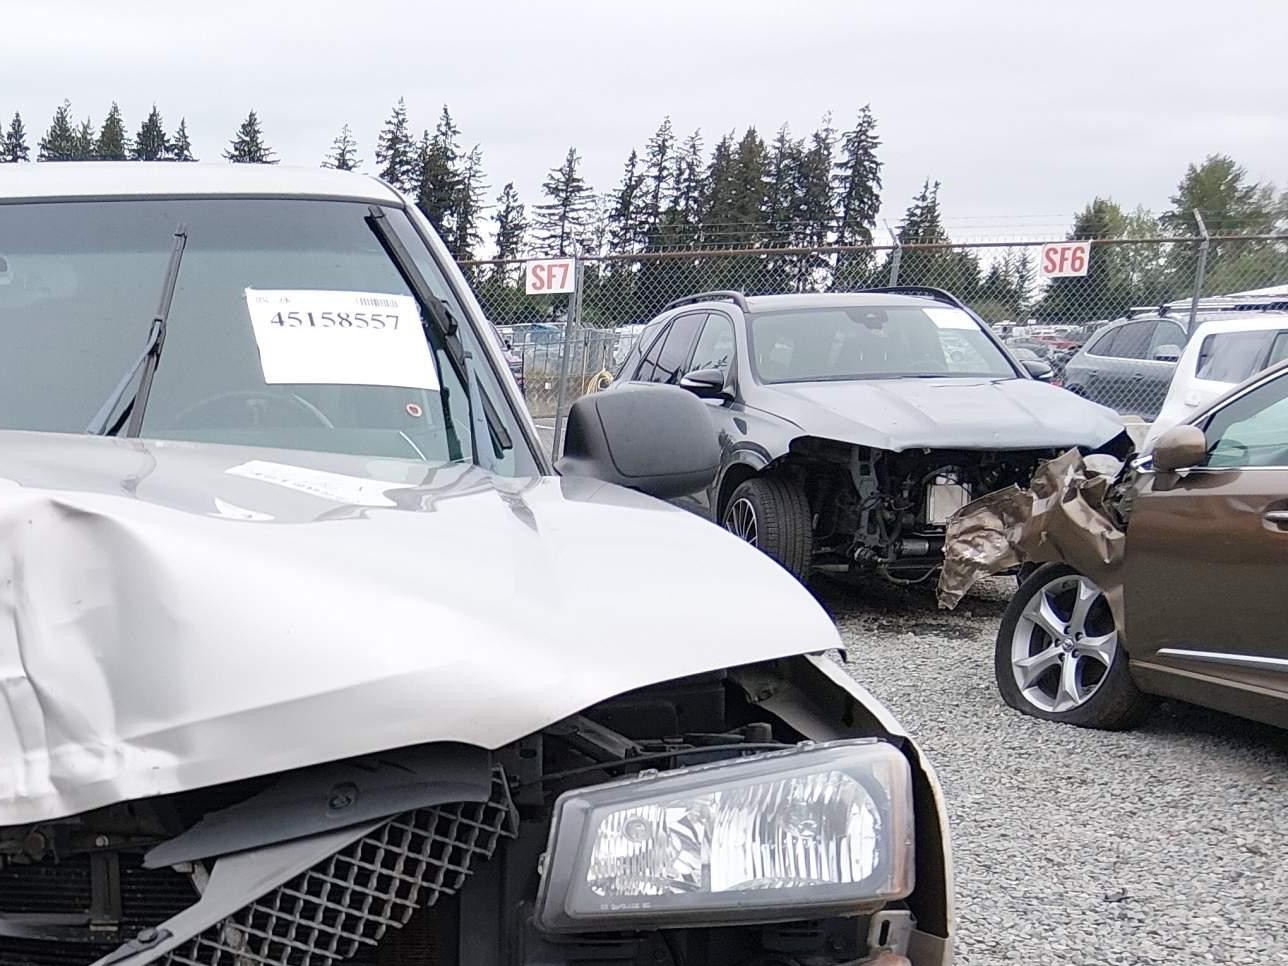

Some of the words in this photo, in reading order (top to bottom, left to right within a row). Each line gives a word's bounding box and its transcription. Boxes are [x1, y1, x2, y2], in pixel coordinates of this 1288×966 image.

[1043, 246, 1086, 273] SF6
[531, 263, 570, 290] SF7
[270, 311, 400, 330] 45158557
